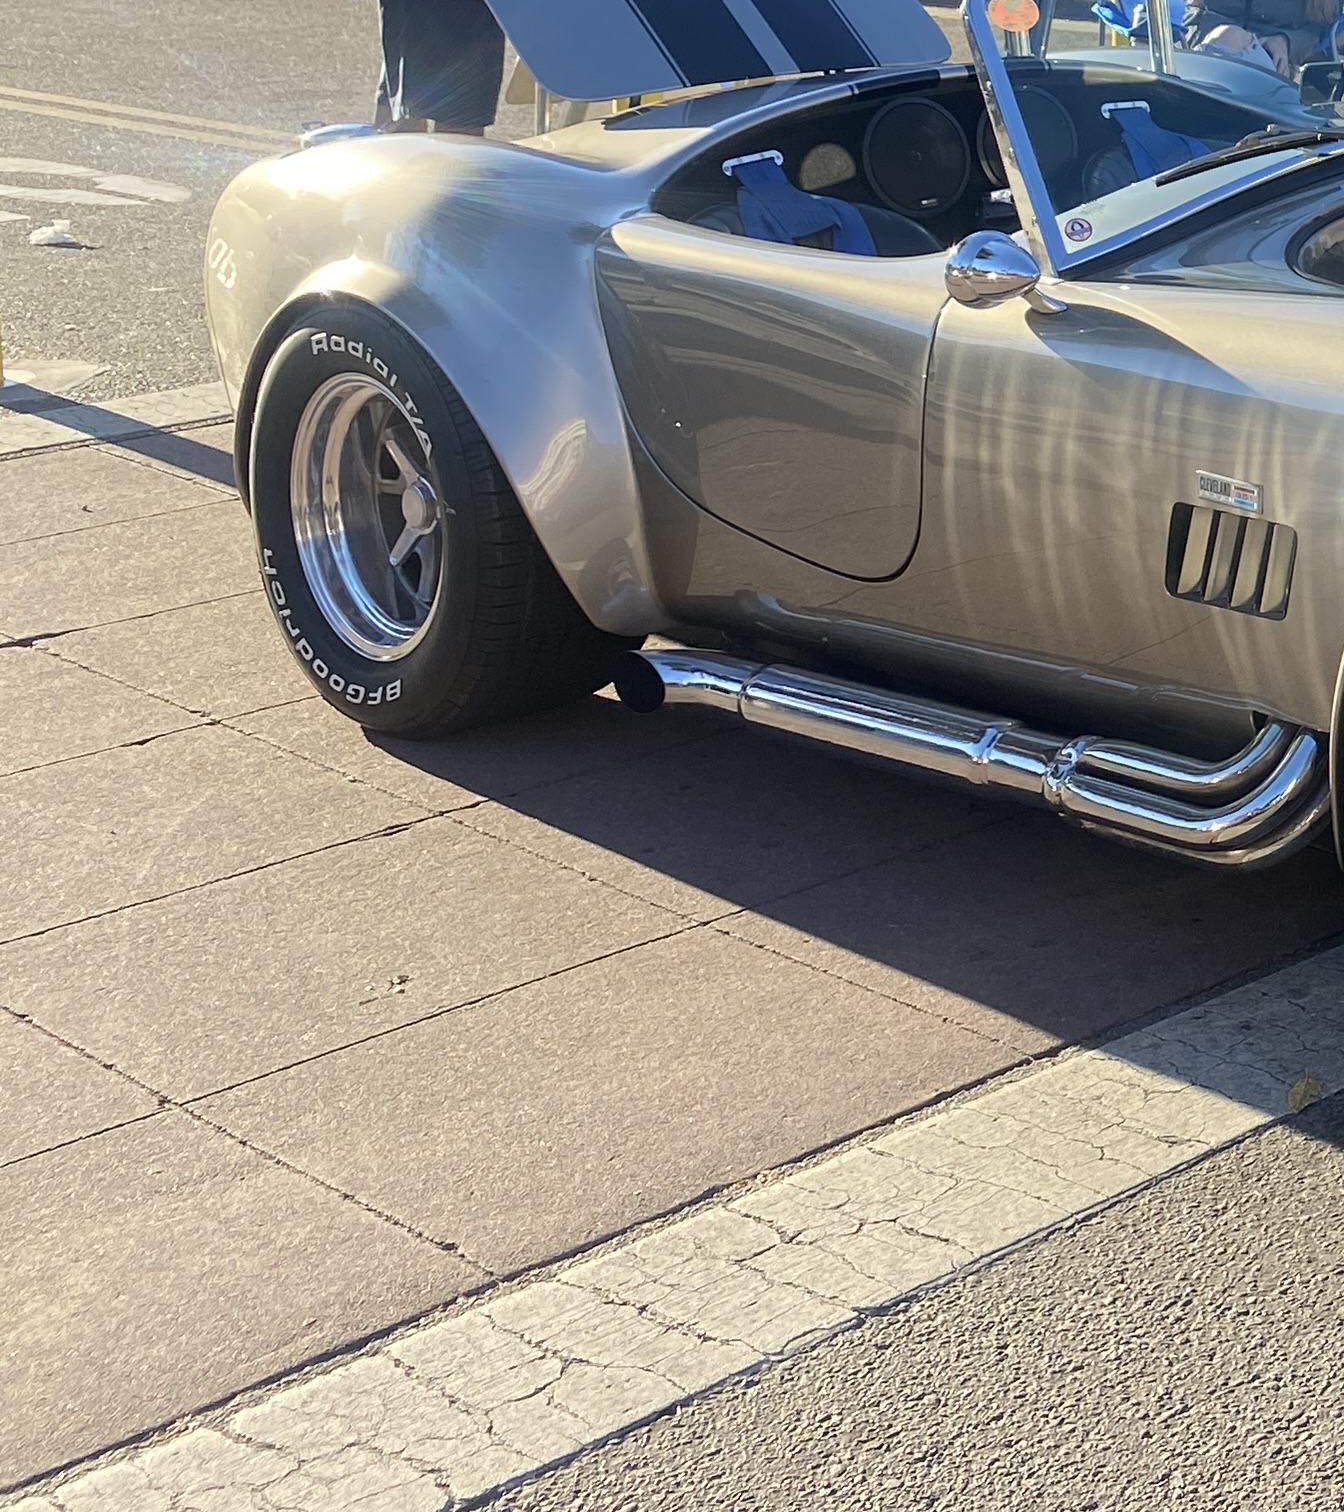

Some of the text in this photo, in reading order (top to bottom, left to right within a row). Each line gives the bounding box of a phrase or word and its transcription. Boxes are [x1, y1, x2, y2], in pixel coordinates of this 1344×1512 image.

[311, 331, 434, 461] Radial T/A
[262, 546, 402, 706] BFGoodrich
